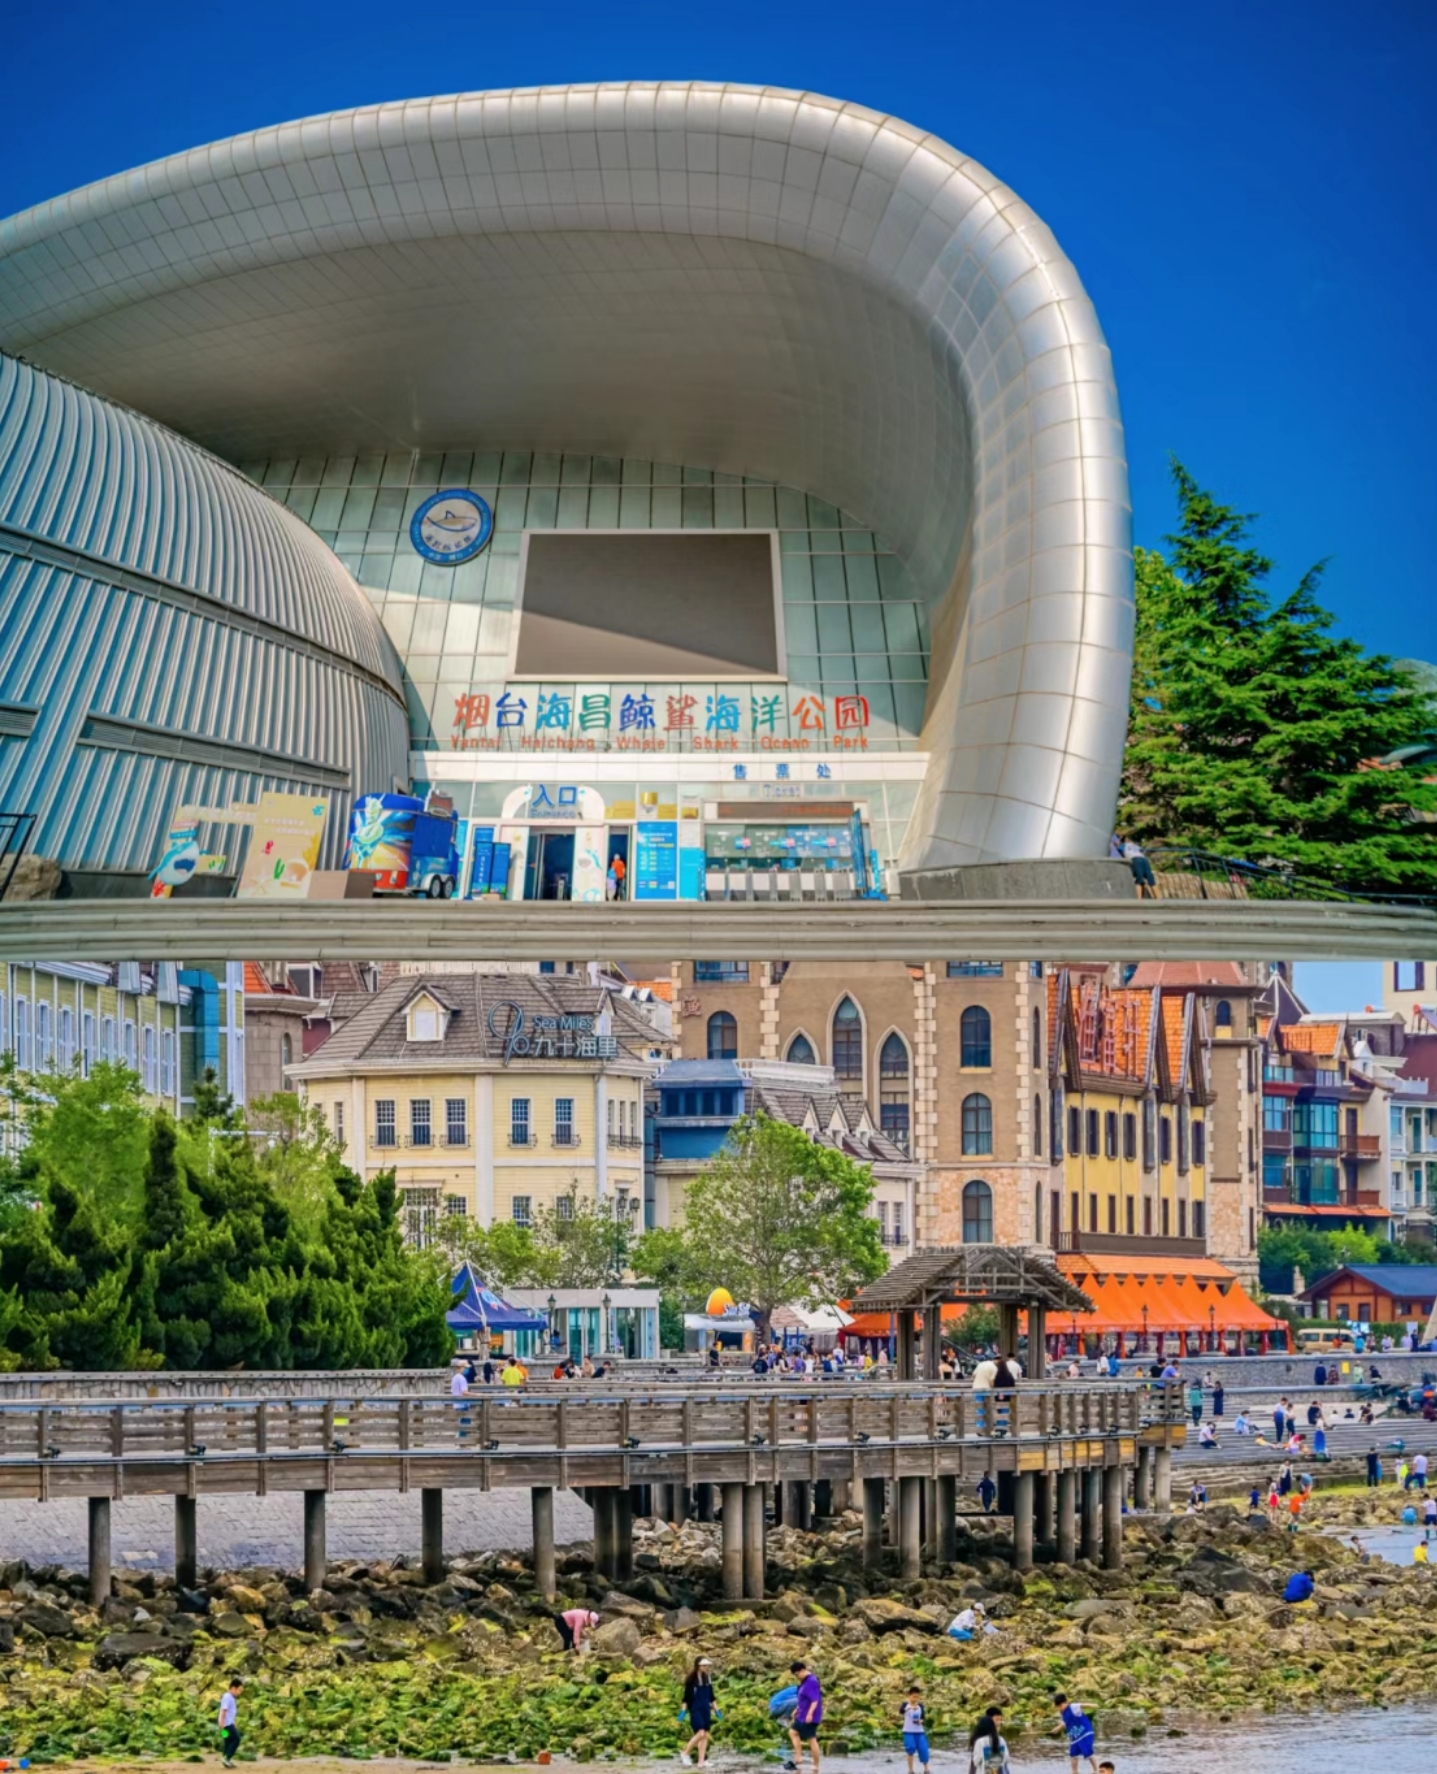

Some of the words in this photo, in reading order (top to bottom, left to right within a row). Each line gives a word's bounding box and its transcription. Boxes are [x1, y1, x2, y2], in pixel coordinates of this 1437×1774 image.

[453, 692, 869, 732] 烟台海昌鲸鲨海洋公园
[451, 734, 502, 749] Yantai
[521, 735, 596, 751] Haichang
[693, 735, 739, 750] Shark
[760, 735, 810, 750] Ocean
[832, 734, 869, 749] Park
[733, 763, 831, 780] 售票处
[532, 784, 578, 808] 入口
[533, 1015, 556, 1030] Sea
[534, 1036, 618, 1058] 九十海里
